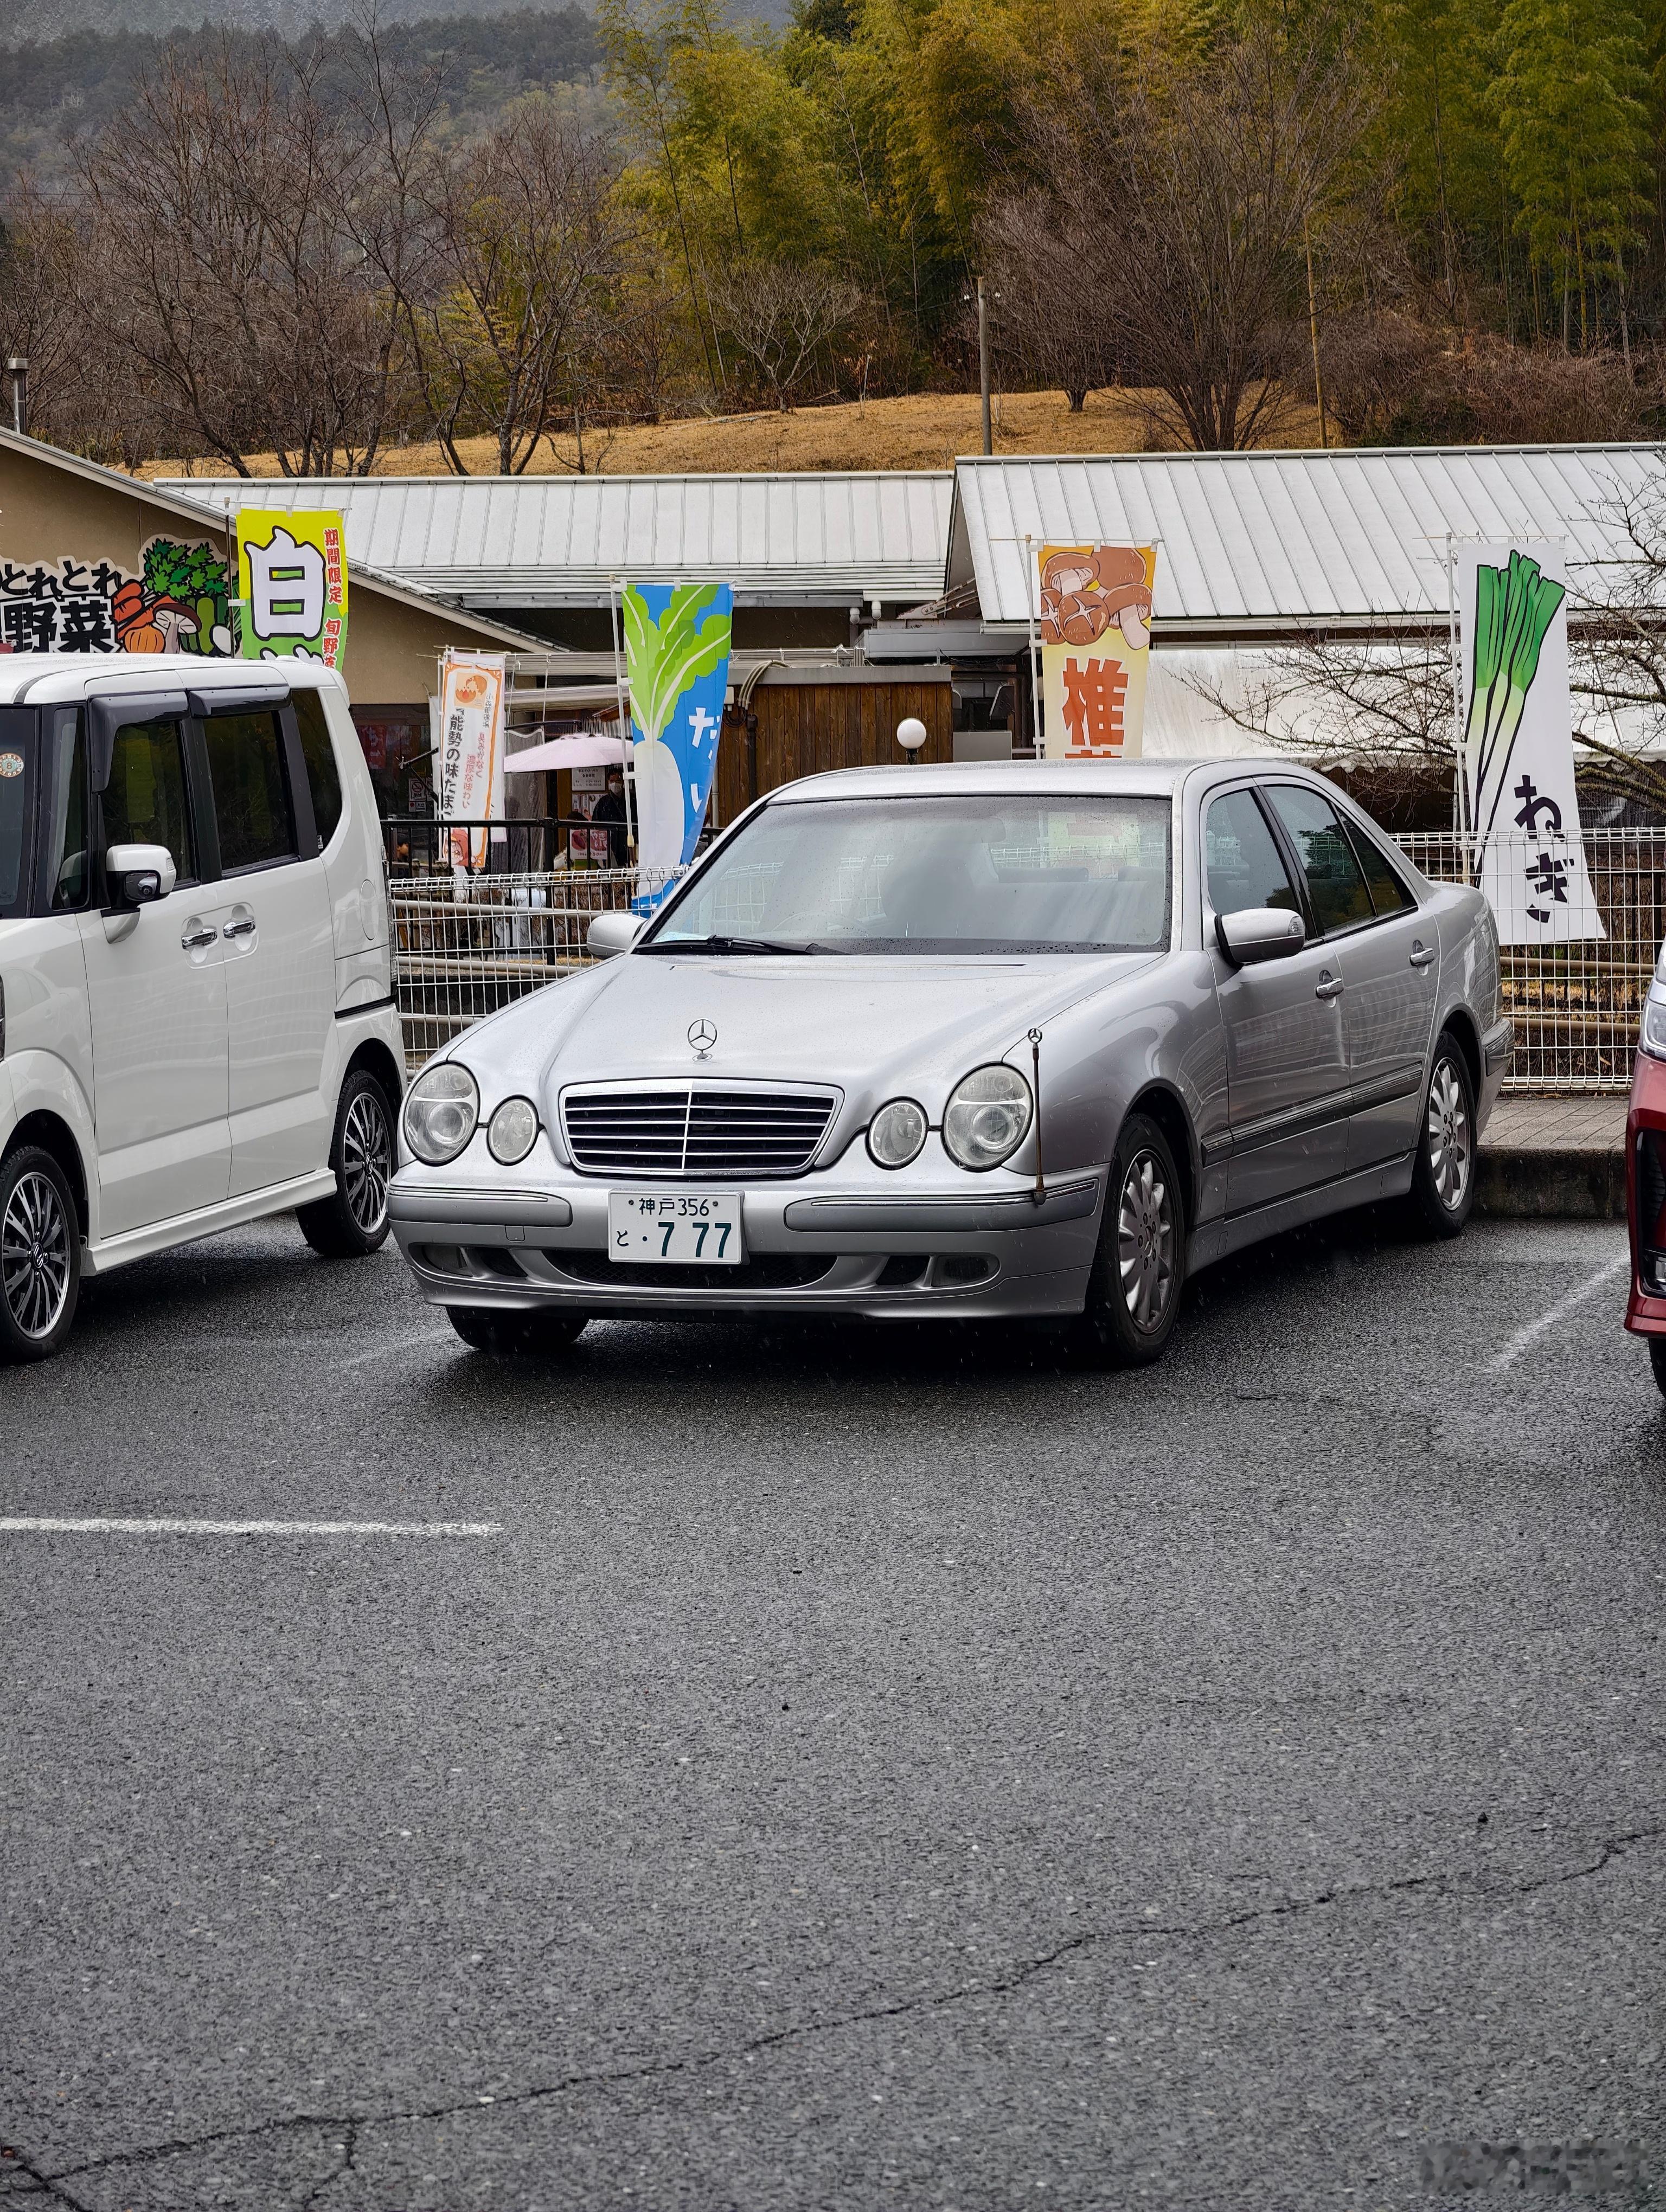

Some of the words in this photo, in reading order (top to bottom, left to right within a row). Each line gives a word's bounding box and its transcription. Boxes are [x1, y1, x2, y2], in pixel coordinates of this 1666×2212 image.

[0, 561, 123, 602] とれとれ
[244, 525, 324, 666] 白
[324, 529, 342, 603] 期間限定
[4, 600, 114, 653] 野菜
[1062, 658, 1129, 759] 椎
[463, 754, 476, 809] 濃厚な味わい
[1514, 775, 1575, 923] ねぎ
